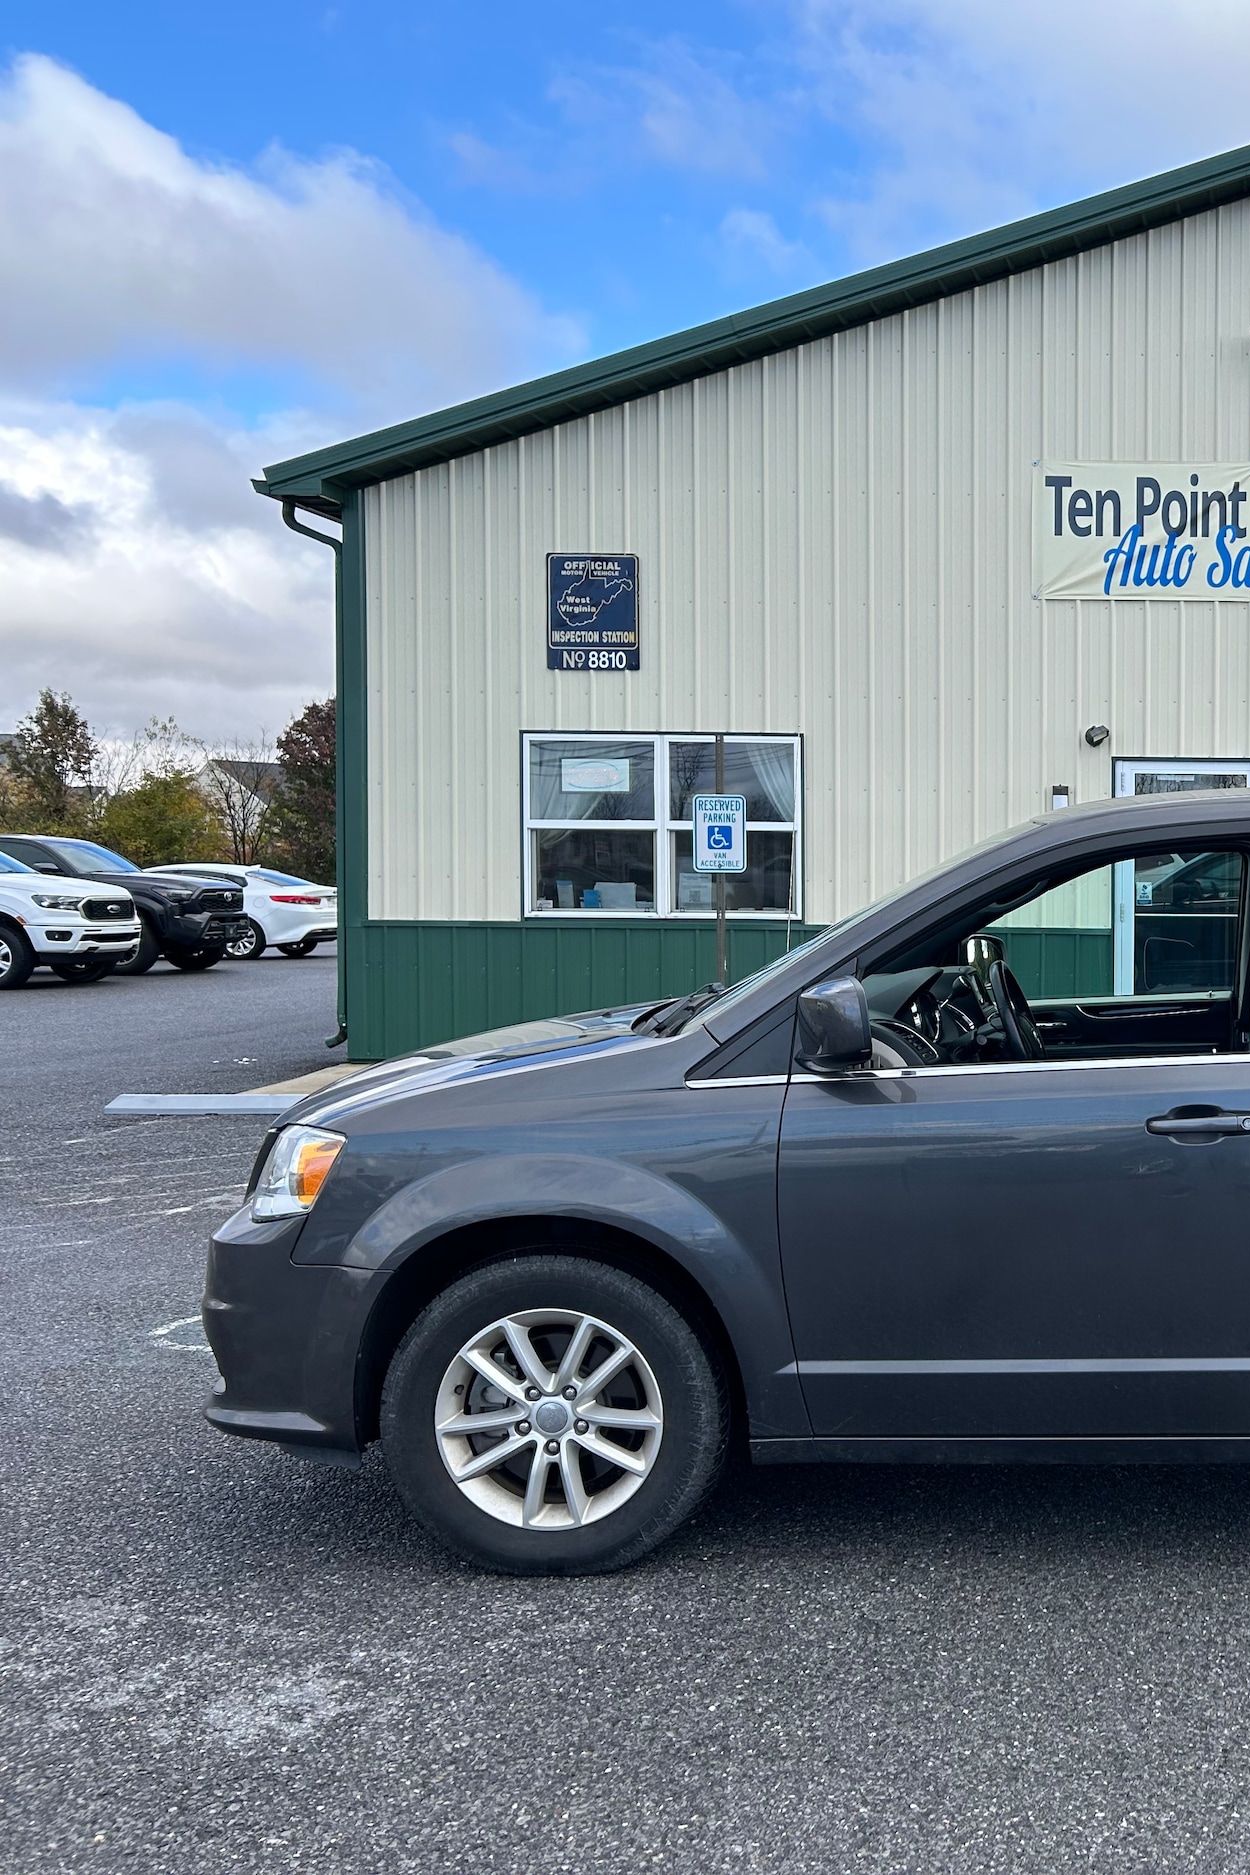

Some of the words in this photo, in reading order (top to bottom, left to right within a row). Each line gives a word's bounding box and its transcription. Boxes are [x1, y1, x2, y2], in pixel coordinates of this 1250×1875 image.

[1045, 475, 1121, 537] Ten
[1136, 473, 1247, 539] Point
[1103, 524, 1197, 595] Auto
[566, 596, 591, 604] West
[559, 604, 597, 613] Virginia
[552, 630, 600, 643] INSPECTION
[602, 631, 635, 643] STATION
[588, 651, 627, 668] 8810
[698, 800, 741, 811] RESERVED
[703, 813, 737, 823] PARKING
[700, 860, 740, 868] ACCESSIBLE
